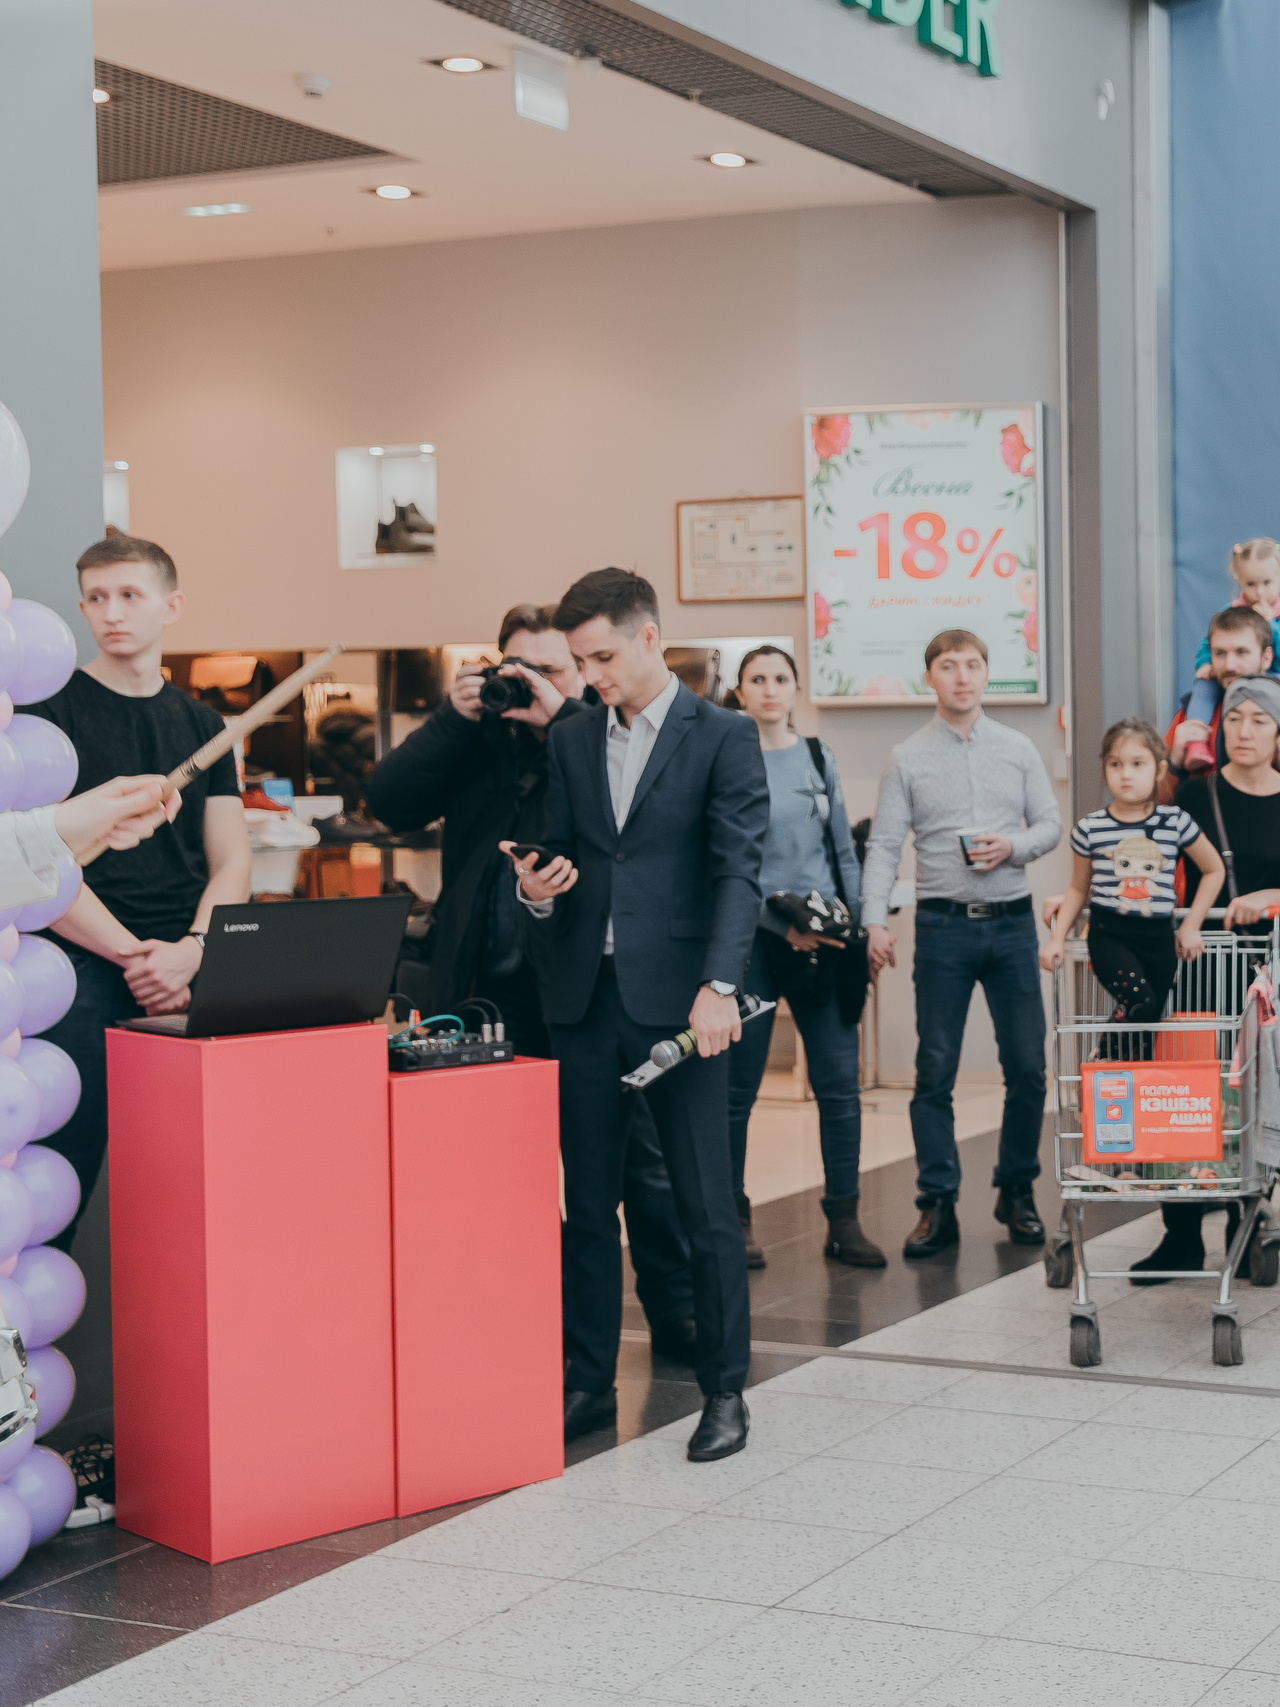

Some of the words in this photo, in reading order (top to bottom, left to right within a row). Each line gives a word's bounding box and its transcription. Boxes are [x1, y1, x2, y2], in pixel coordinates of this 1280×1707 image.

[833, 512, 1018, 580] -18%
[223, 922, 260, 933] Lenovo
[1139, 1084, 1190, 1096] ПОЛУЧИ
[1140, 1096, 1212, 1112] КЭШБЭК
[1169, 1112, 1213, 1125] АШАН
